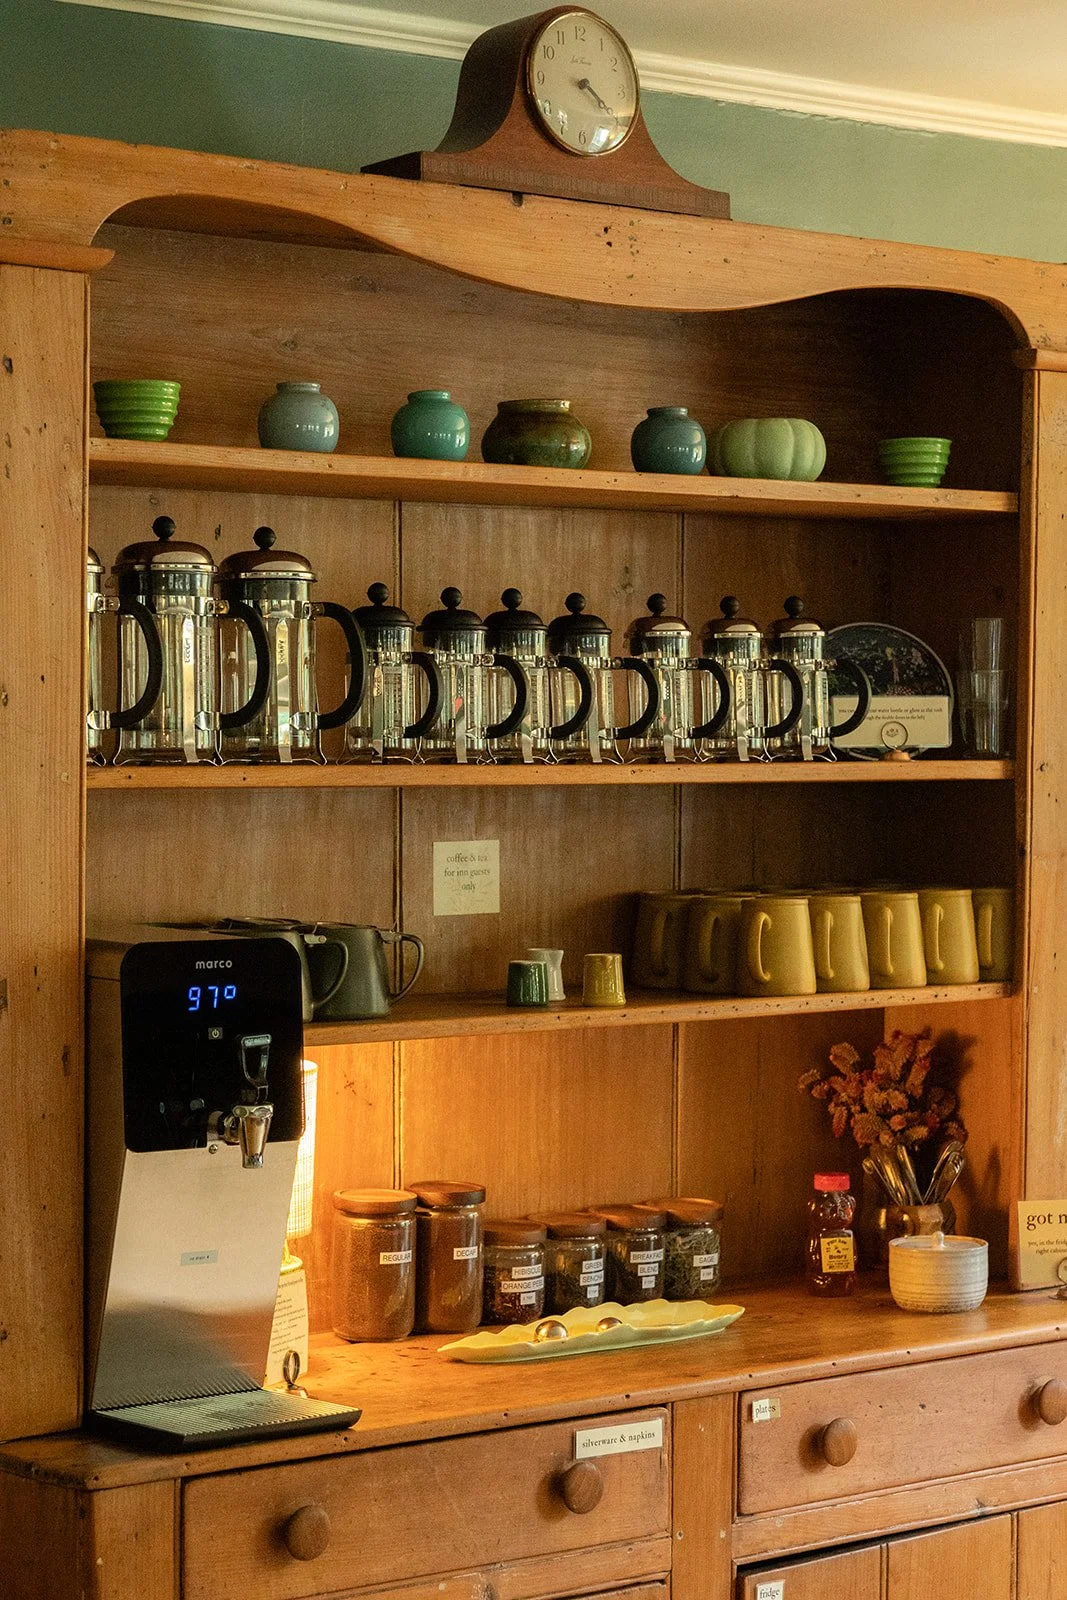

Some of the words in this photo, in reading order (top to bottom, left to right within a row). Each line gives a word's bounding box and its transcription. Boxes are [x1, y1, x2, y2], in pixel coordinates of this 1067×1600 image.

[556, 30, 565, 45] 11
[574, 25, 586, 42] 12
[599, 38, 604, 52] 1
[542, 44, 555, 61] 10
[609, 57, 617, 73] 2
[536, 71, 545, 86] 9
[617, 84, 626, 99] 3
[578, 130, 587, 145] 6
[446, 852, 468, 863] coffee
[444, 867, 455, 877] for
[456, 867, 469, 876] inn
[470, 868, 490, 878] guests
[195, 960, 233, 970] marco
[1026, 1212, 1053, 1232] got
[382, 1252, 411, 1262] REGULAR
[455, 1248, 477, 1258] DECAF
[698, 1255, 715, 1264] SAGE
[514, 1266, 541, 1276] HIBISCUS
[502, 1281, 532, 1291] ORANGE
[755, 1404, 777, 1418] plates
[582, 1437, 618, 1449] silverware
[619, 1433, 626, 1443] &
[628, 1429, 656, 1444] napkins
[759, 1587, 780, 1600] fridge
